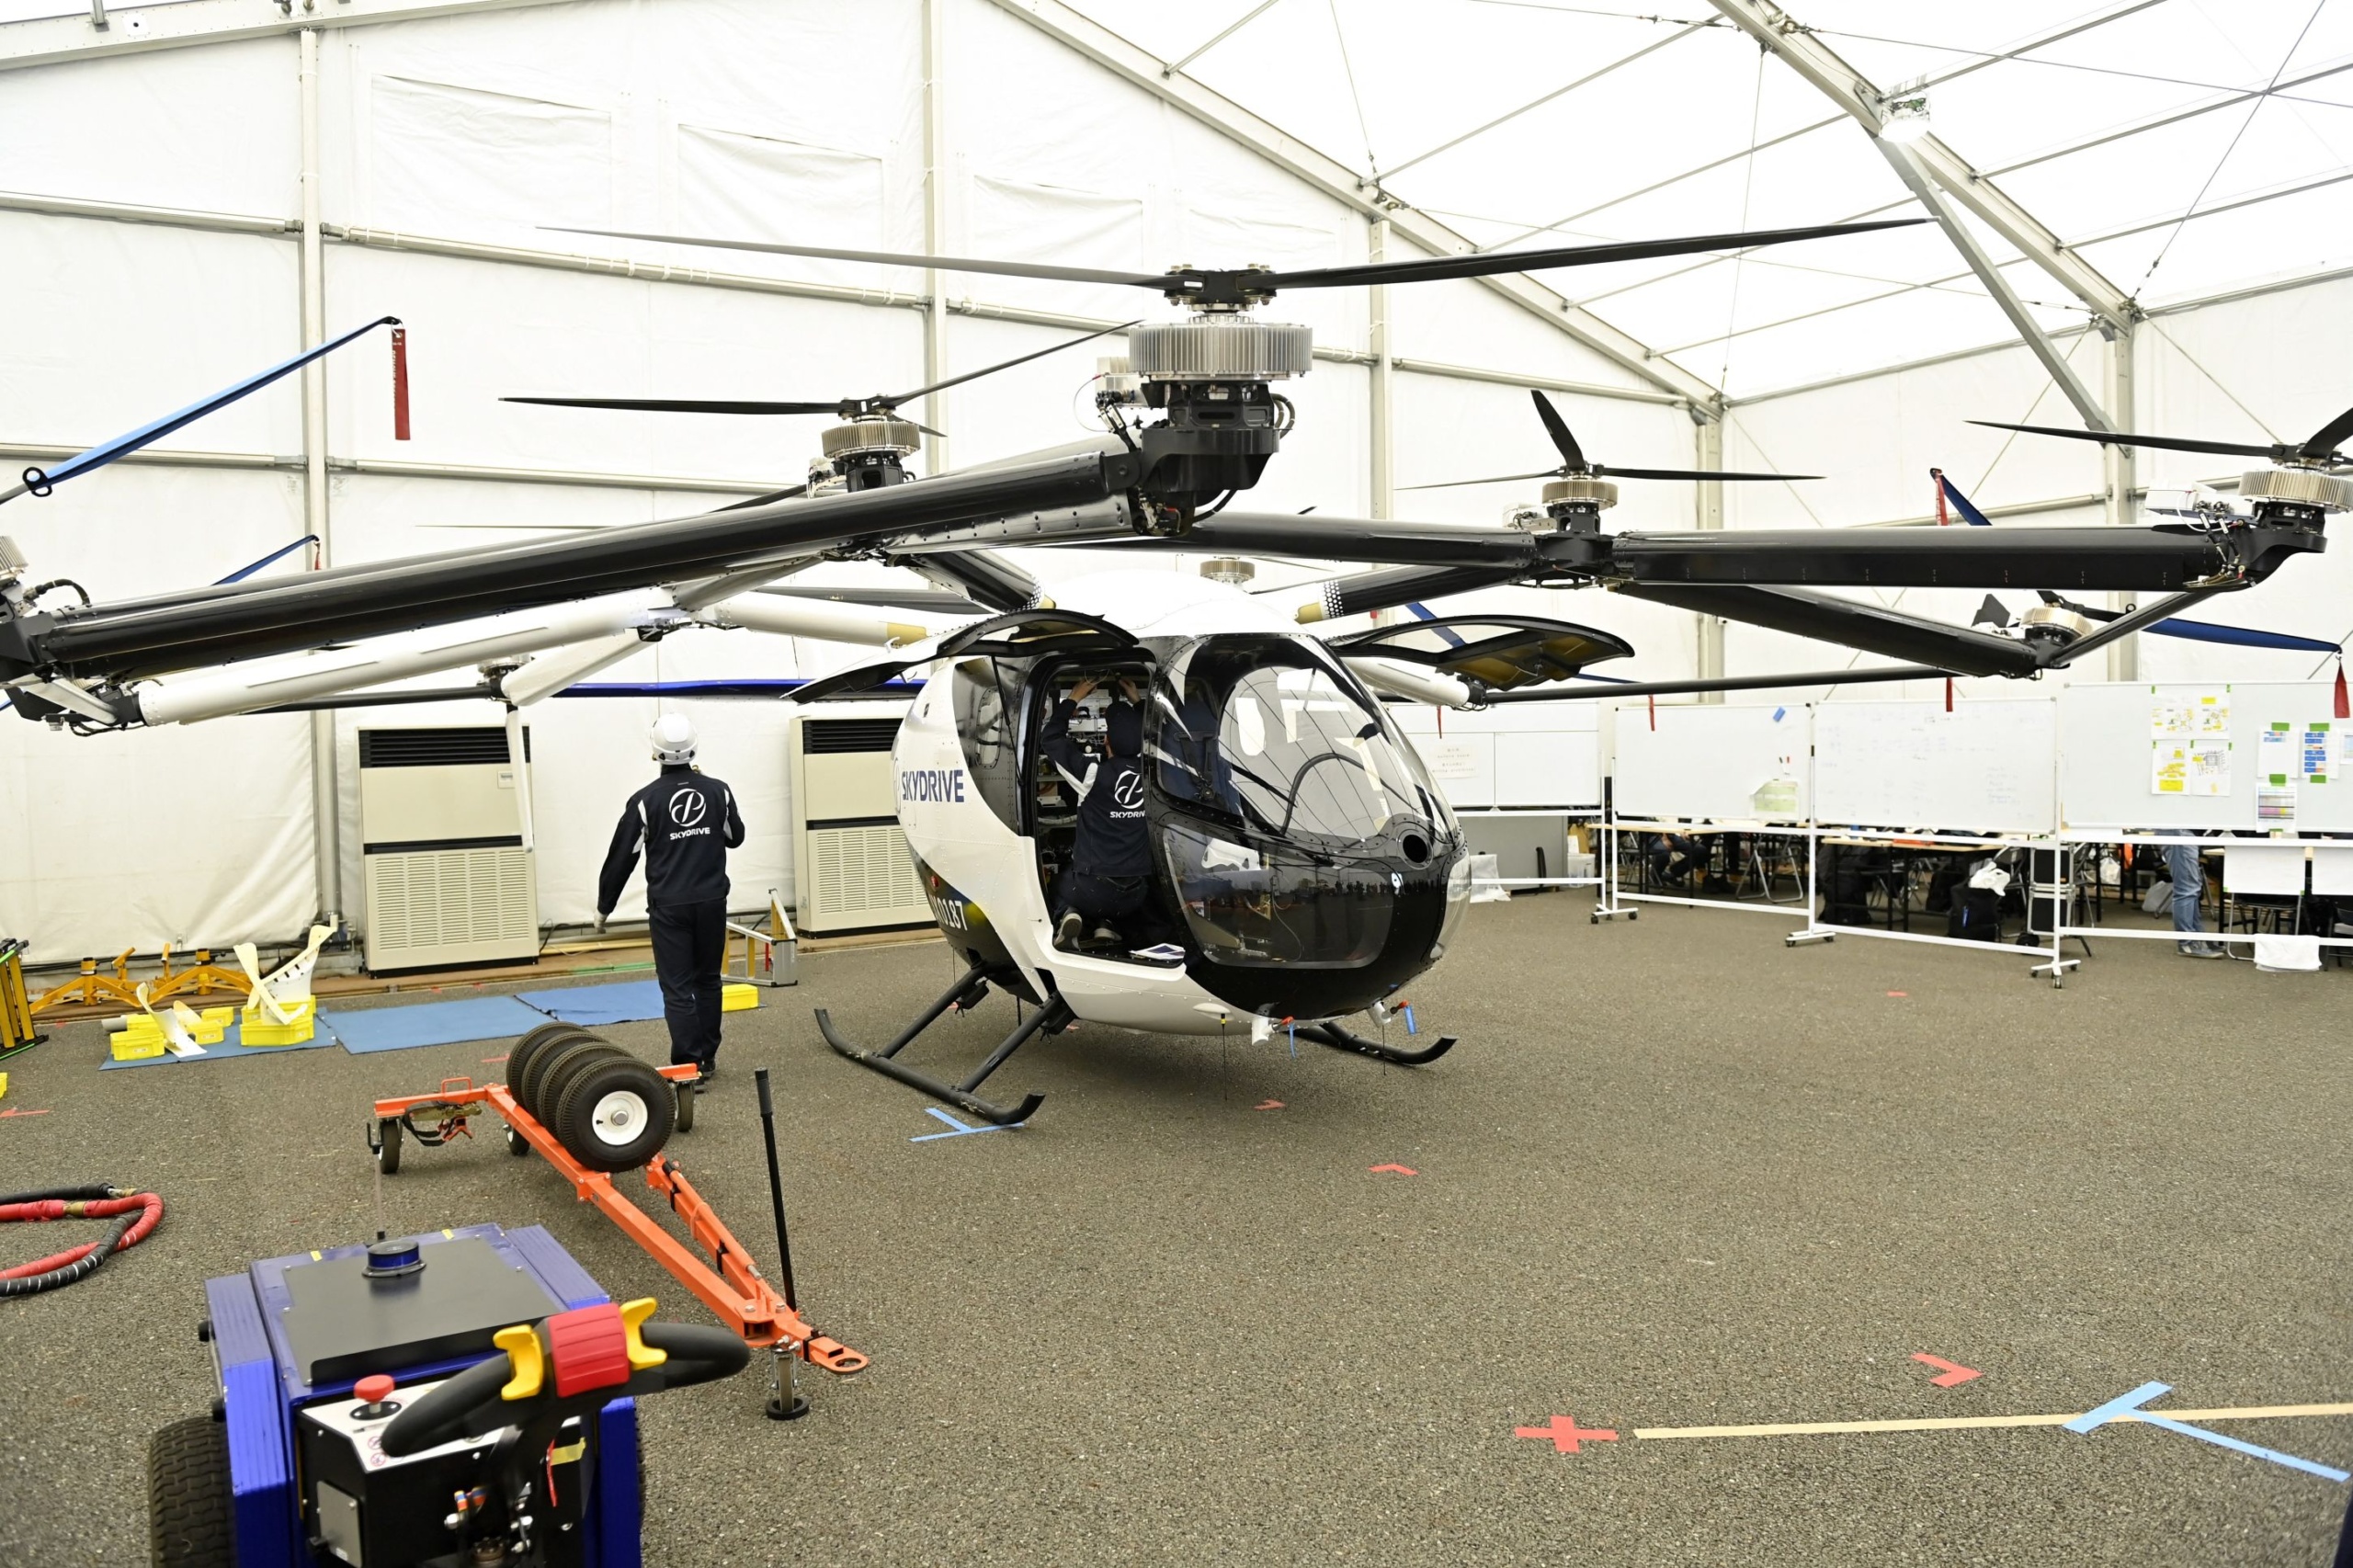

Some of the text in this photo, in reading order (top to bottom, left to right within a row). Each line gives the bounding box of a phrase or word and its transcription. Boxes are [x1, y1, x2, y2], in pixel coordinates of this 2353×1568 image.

[902, 769, 965, 803] SKYDRIVE
[1109, 810, 1145, 818] SKYDRIV
[669, 827, 710, 840] SKYDRIVE
